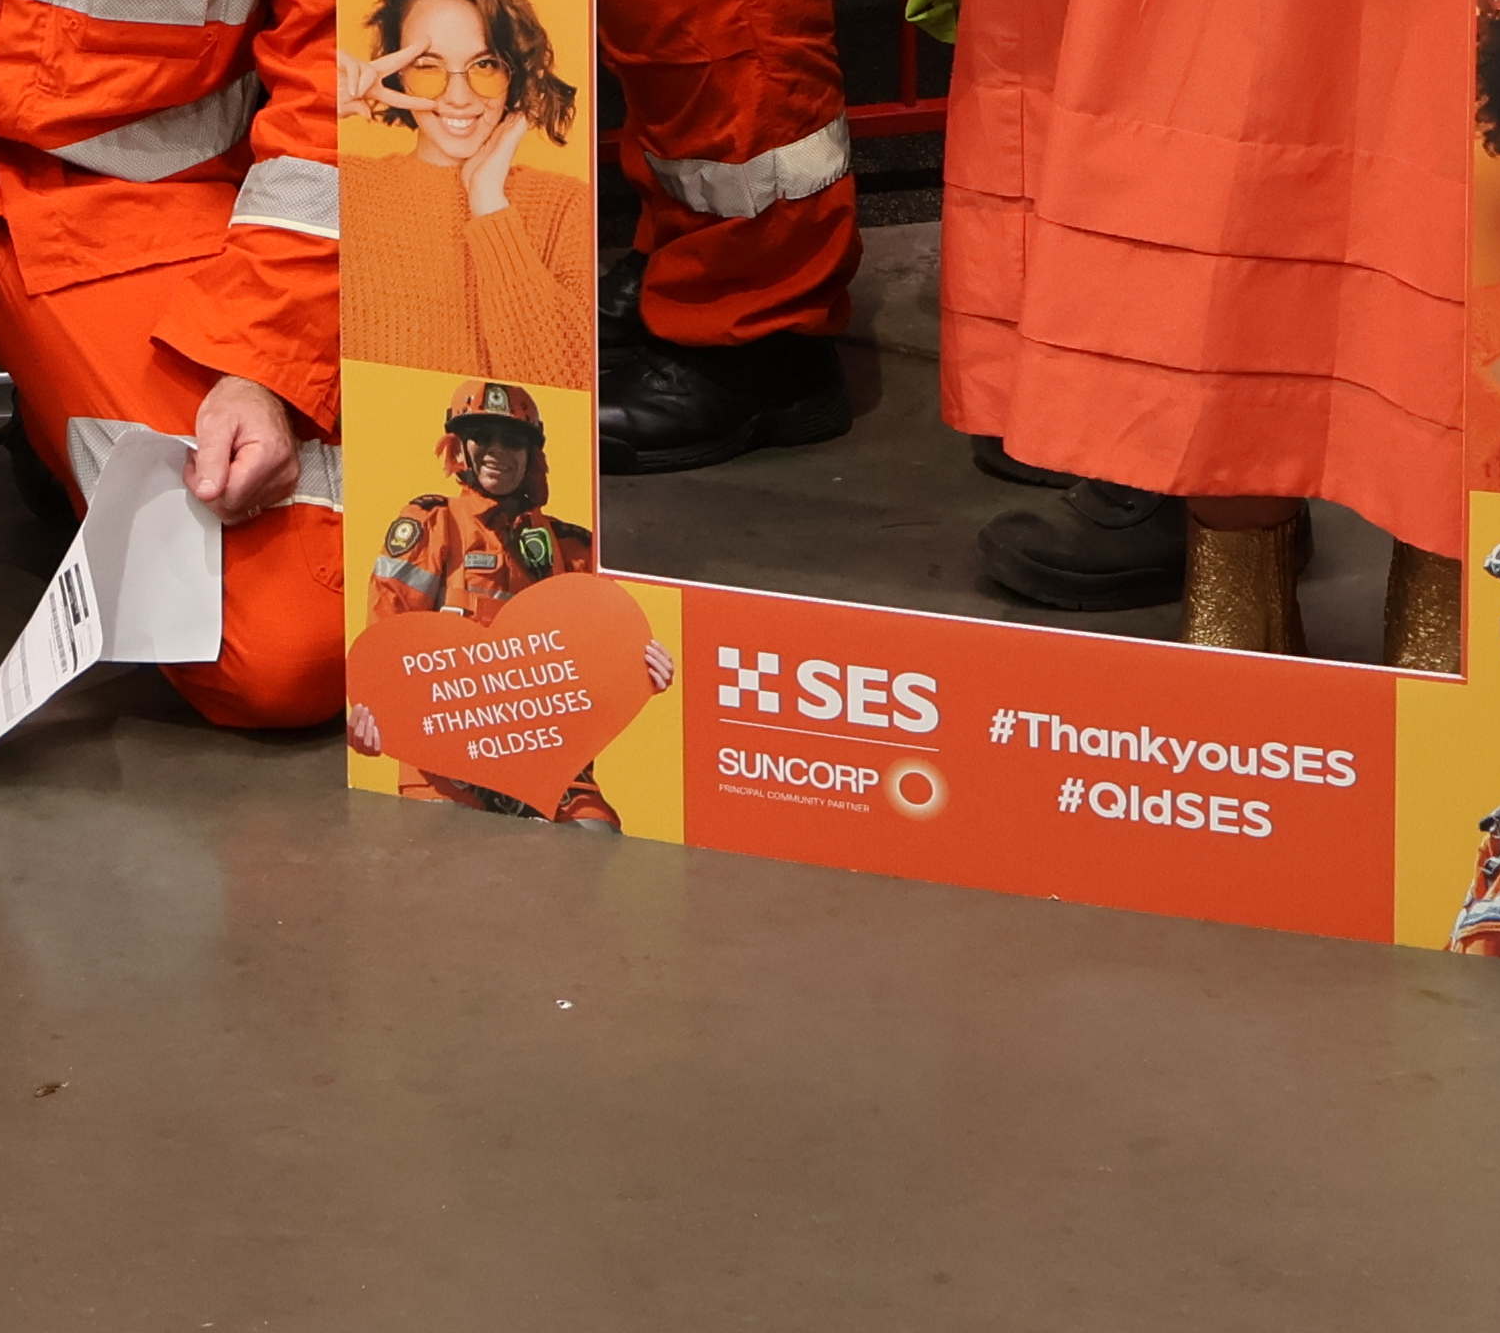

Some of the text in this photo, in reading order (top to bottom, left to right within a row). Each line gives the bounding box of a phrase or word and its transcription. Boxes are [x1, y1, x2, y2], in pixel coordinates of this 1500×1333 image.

[402, 630, 566, 676] POST YOUR PIC
[431, 659, 579, 703] AND INCLUDE
[796, 657, 940, 733] SES
[422, 689, 593, 736] #THANKYOUSES
[466, 726, 564, 760] #QLDSES
[988, 707, 1356, 788] #ThankyouSES
[718, 747, 880, 795] SUNCORP
[718, 782, 871, 815] PRINCIPAL COMMUNITY PARTNER
[1057, 776, 1273, 838] #QldSES
